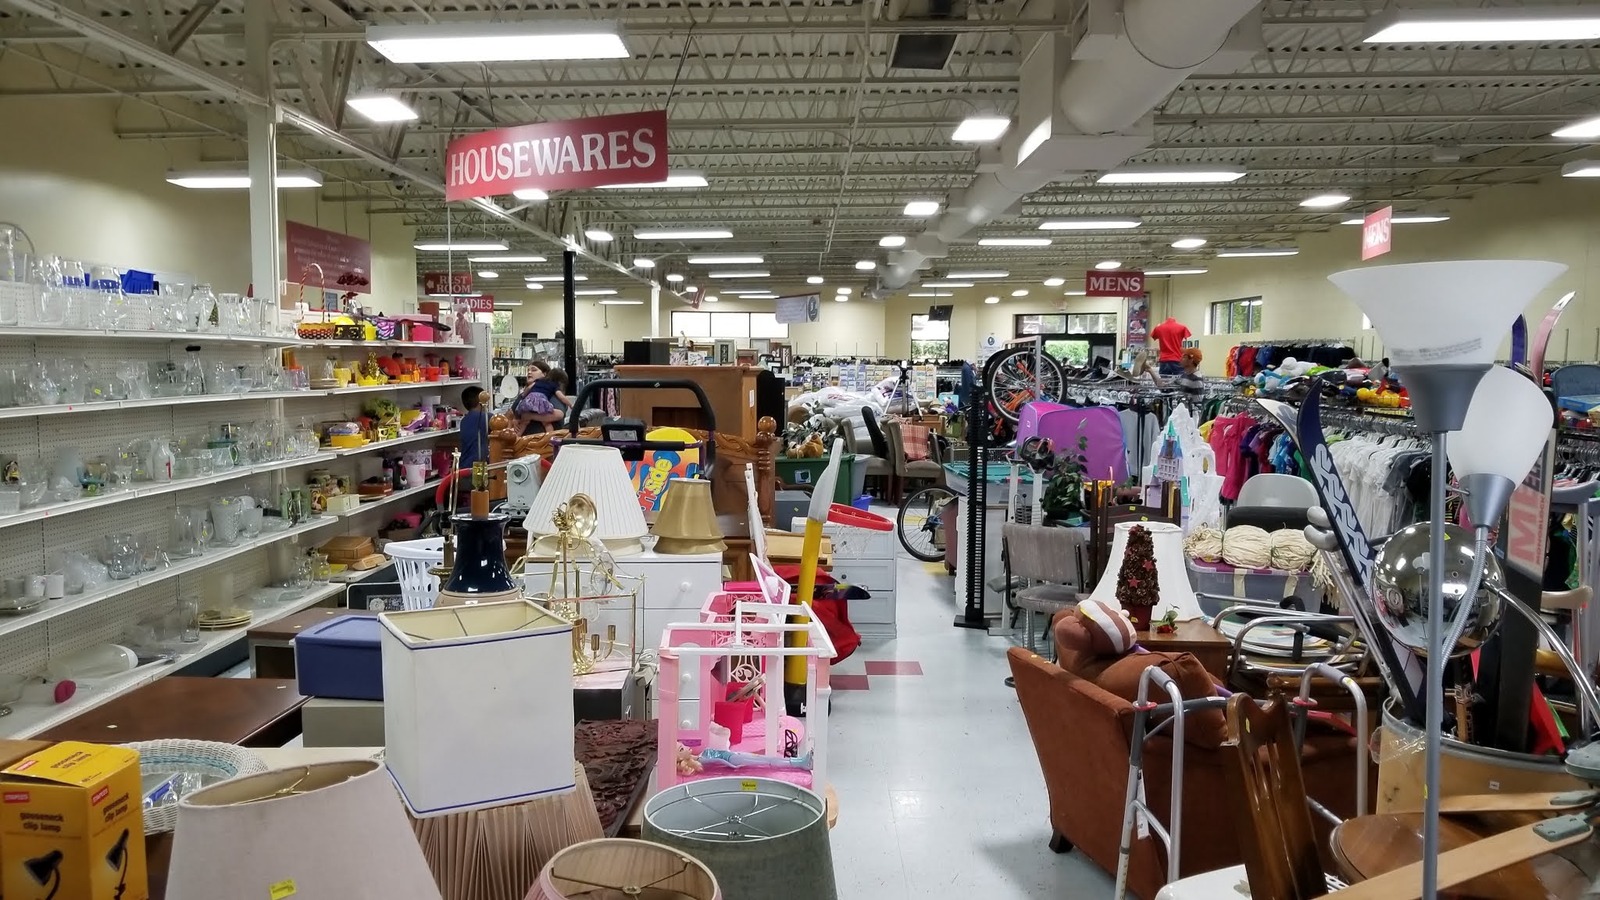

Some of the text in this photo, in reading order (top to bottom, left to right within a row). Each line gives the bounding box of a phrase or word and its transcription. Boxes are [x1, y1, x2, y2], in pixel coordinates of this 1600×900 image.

[450, 128, 656, 186] HOUSEWARES
[439, 275, 467, 285] REST
[1089, 276, 1141, 292] MENS
[436, 284, 470, 293] ROOM
[23, 821, 61, 832] clip lamp
